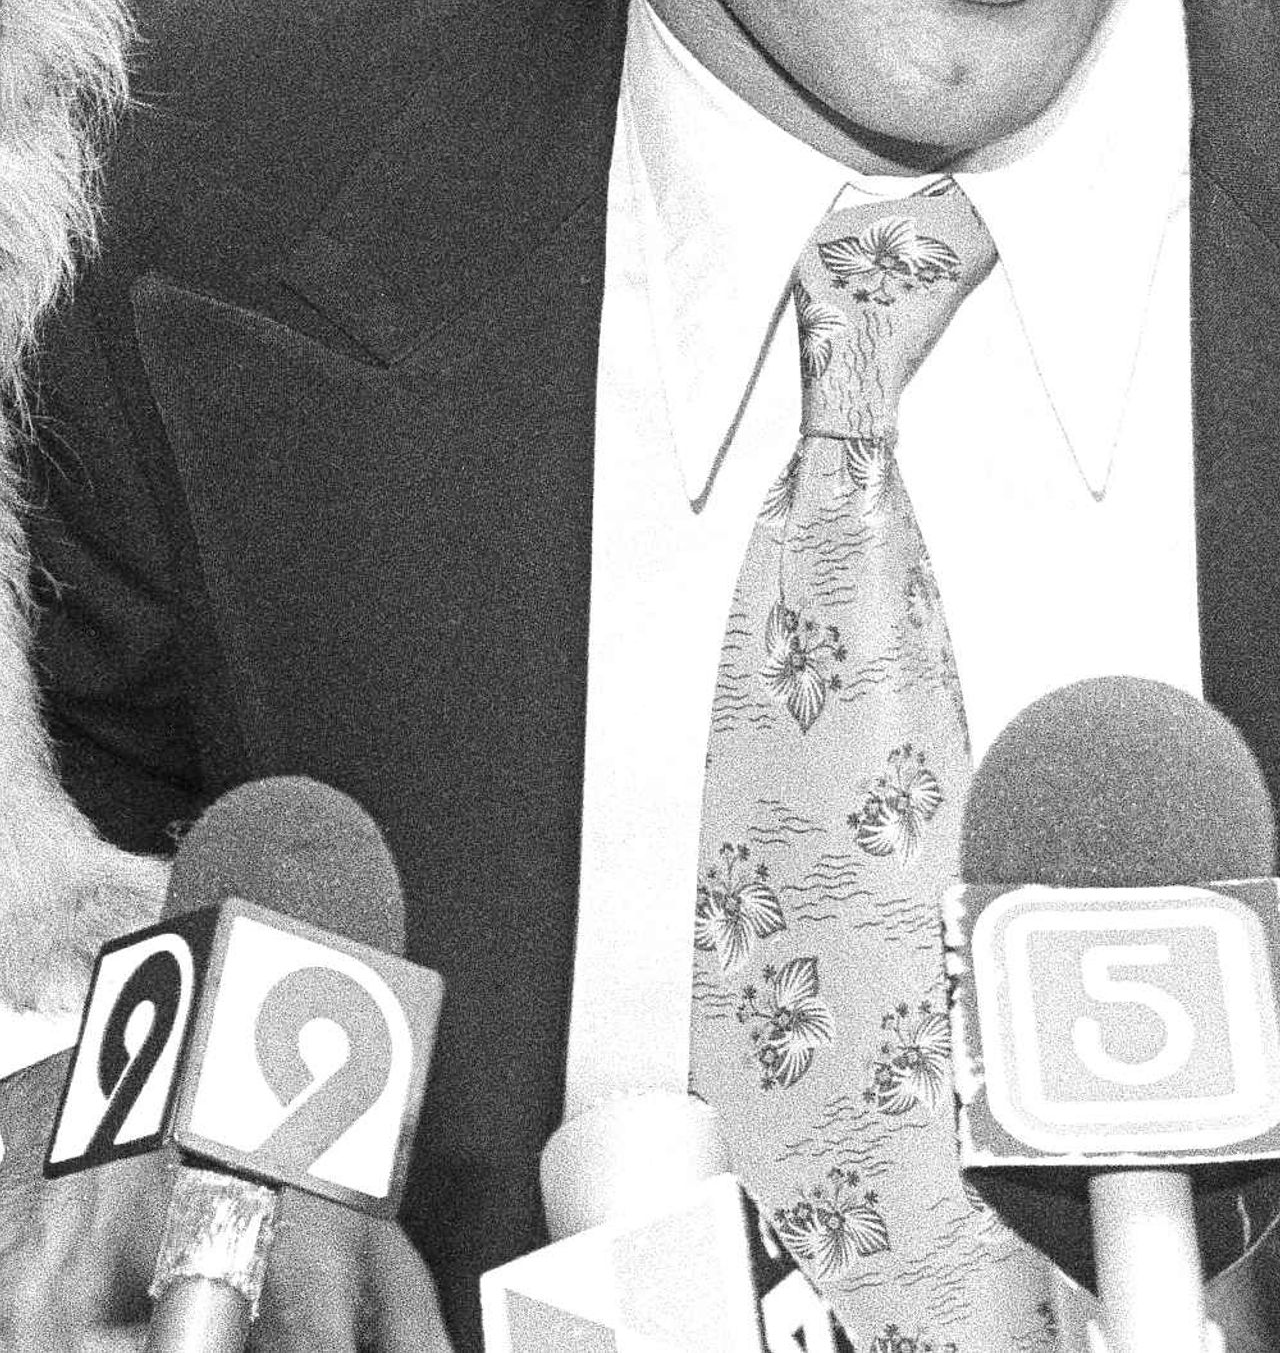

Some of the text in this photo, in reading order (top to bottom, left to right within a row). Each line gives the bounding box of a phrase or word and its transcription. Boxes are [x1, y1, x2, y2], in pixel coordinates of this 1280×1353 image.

[85, 949, 182, 1154] 9
[251, 965, 393, 1174] 9
[1071, 945, 1195, 1086] 5
